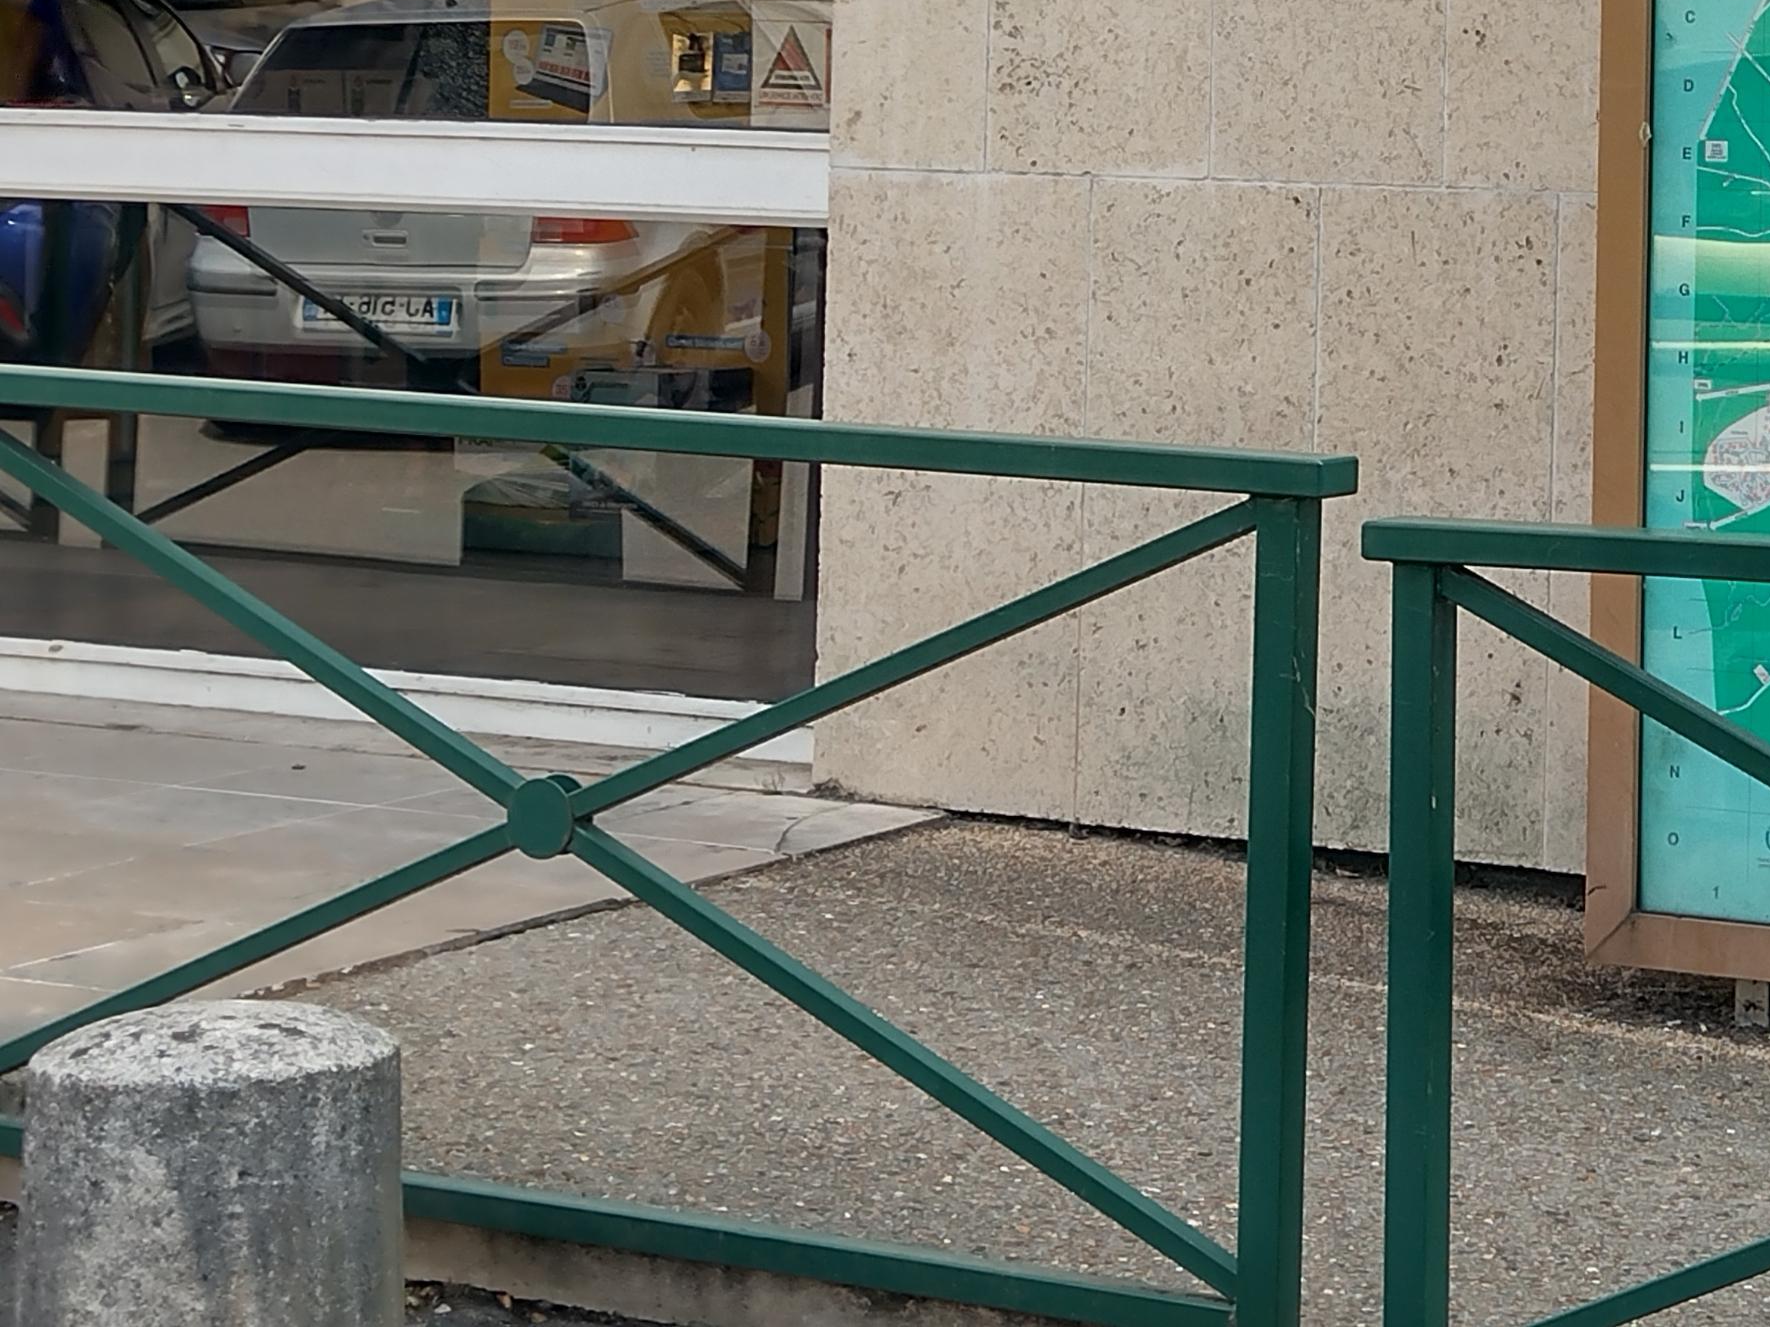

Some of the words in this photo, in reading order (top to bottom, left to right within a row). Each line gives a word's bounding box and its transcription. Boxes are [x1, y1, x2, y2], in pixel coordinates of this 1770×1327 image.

[1684, 10, 1696, 24] C
[1683, 78, 1695, 93] D
[1682, 146, 1692, 160] E
[1681, 214, 1691, 228] F
[1678, 282, 1691, 298] G
[1678, 350, 1689, 365] H
[1675, 489, 1685, 503] J
[1673, 625, 1683, 640] L
[1669, 764, 1680, 779] N
[1667, 831, 1680, 846] O
